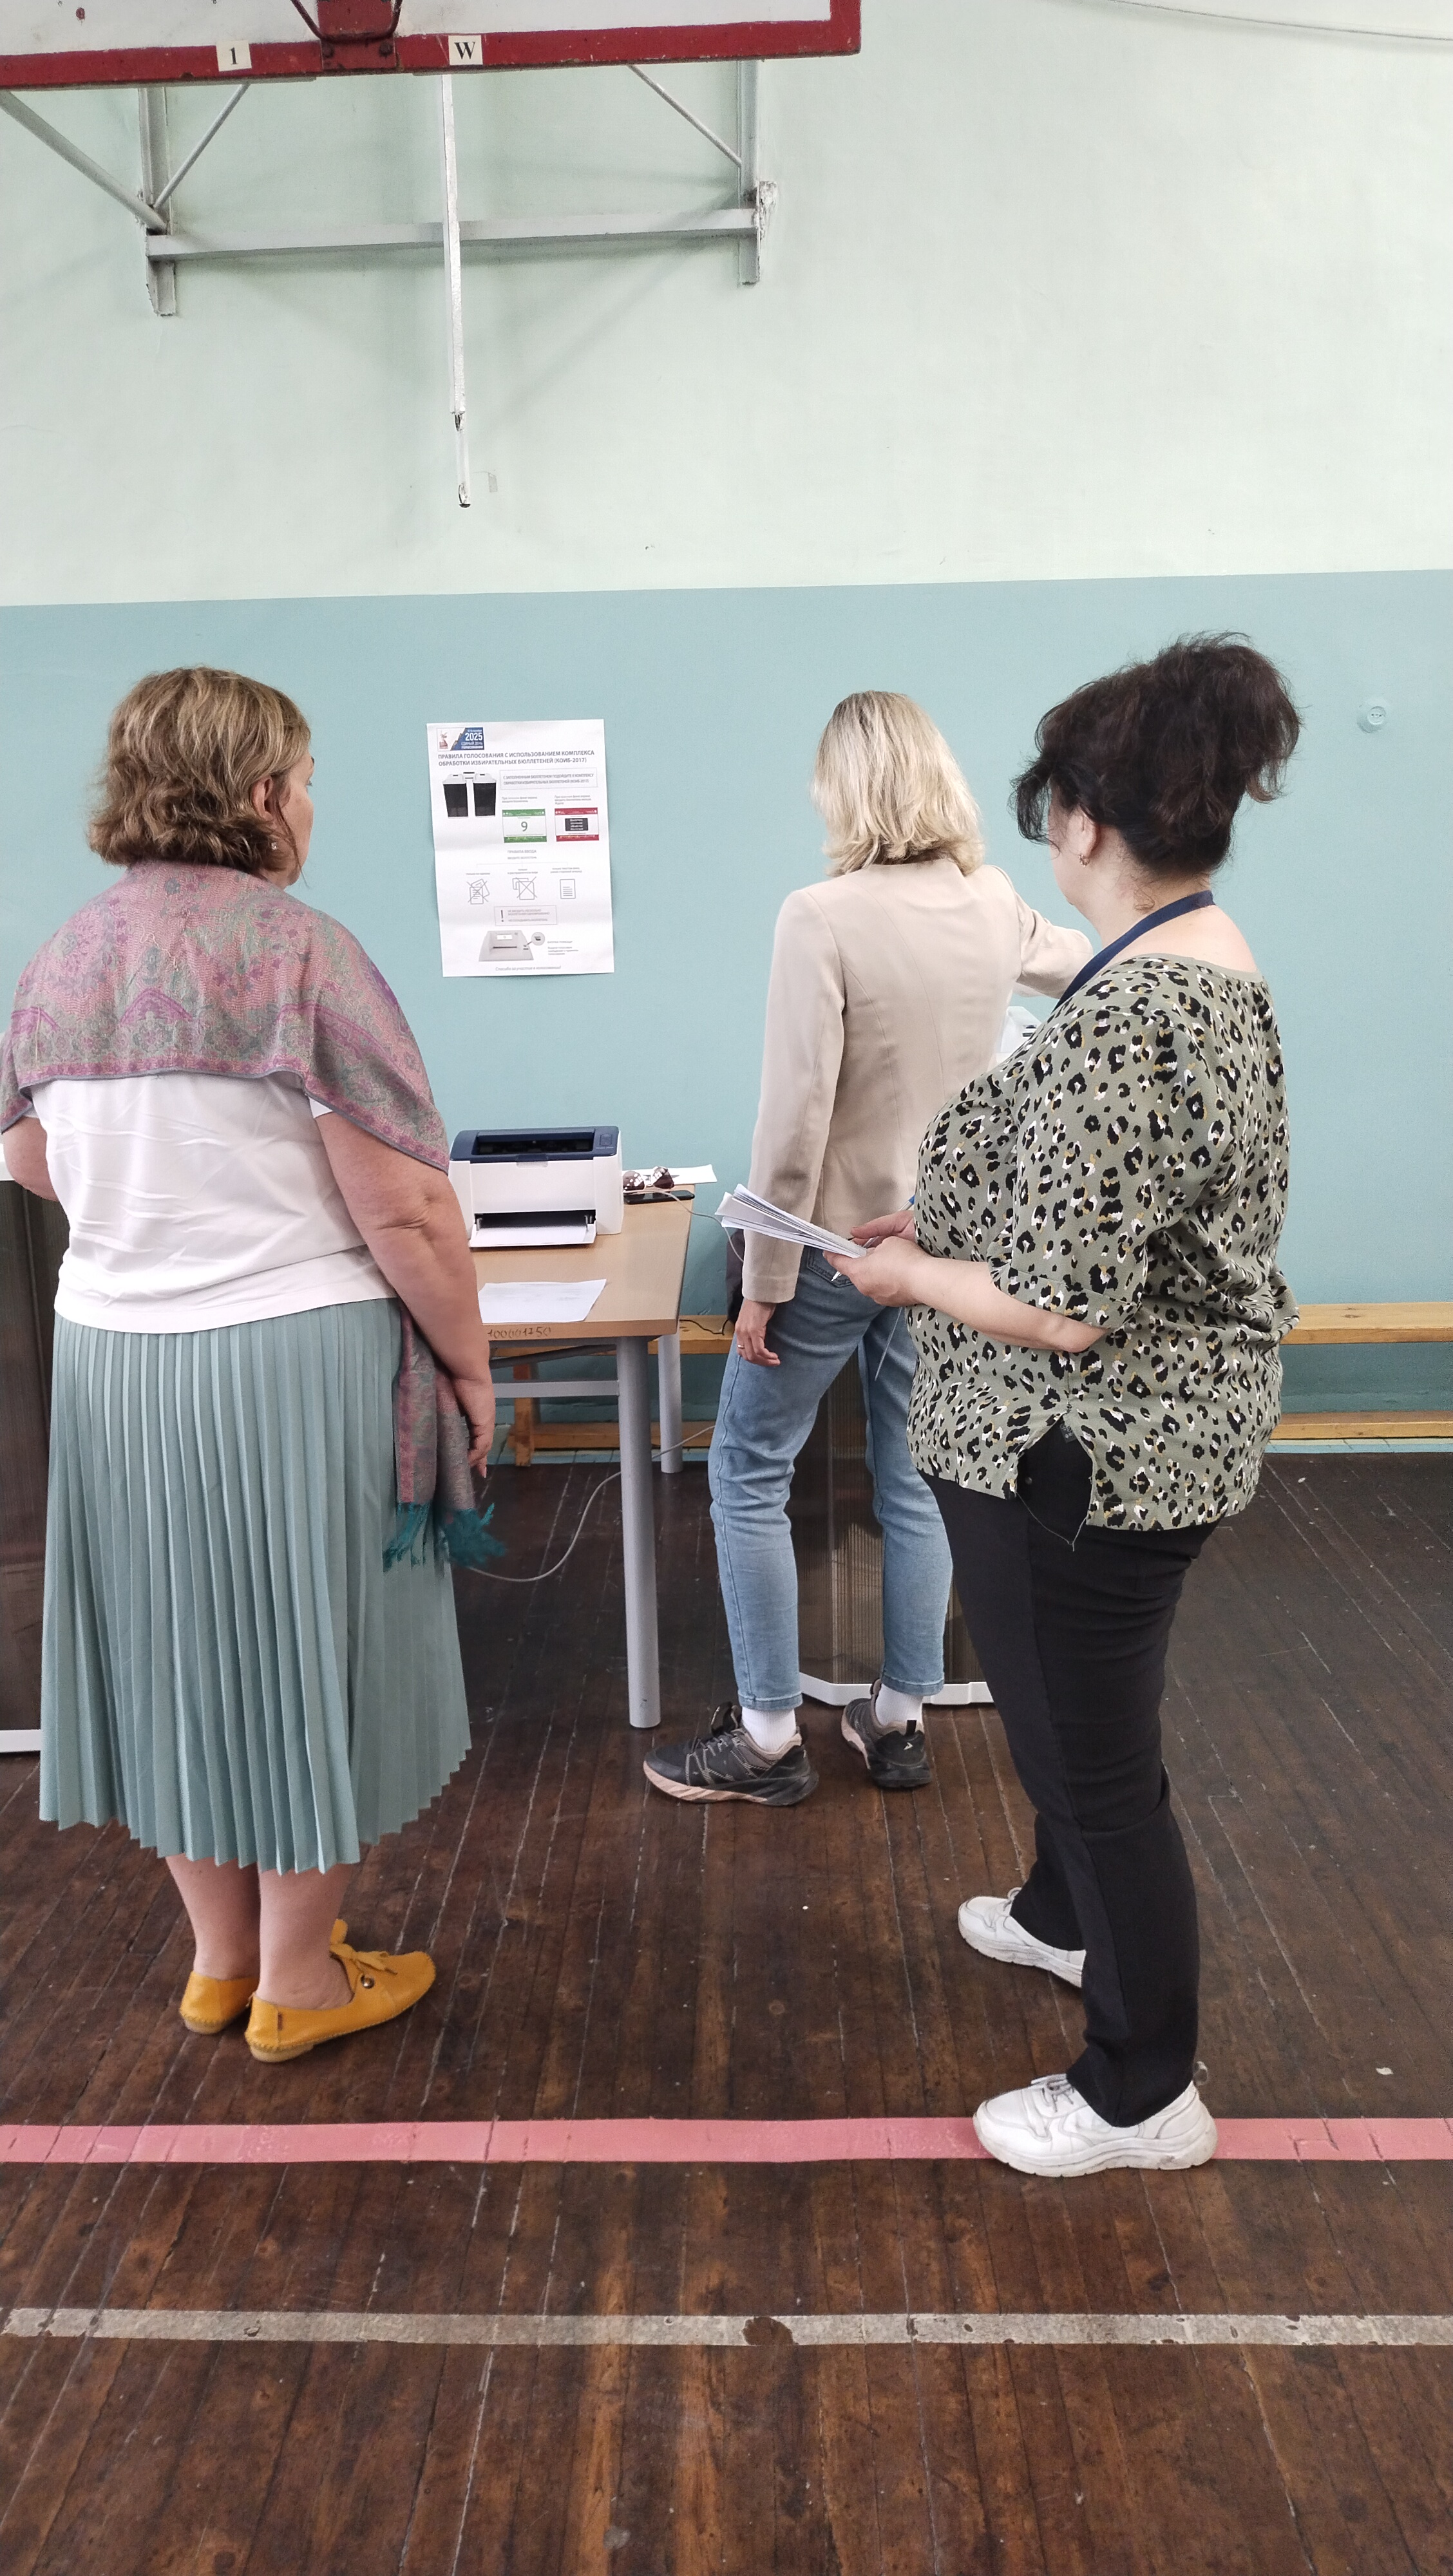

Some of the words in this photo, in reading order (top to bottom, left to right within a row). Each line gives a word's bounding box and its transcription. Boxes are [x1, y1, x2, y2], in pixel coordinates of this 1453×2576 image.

[229, 47, 239, 65] 1
[454, 41, 476, 60] W
[465, 732, 483, 741] 2025
[521, 821, 527, 831] 9
